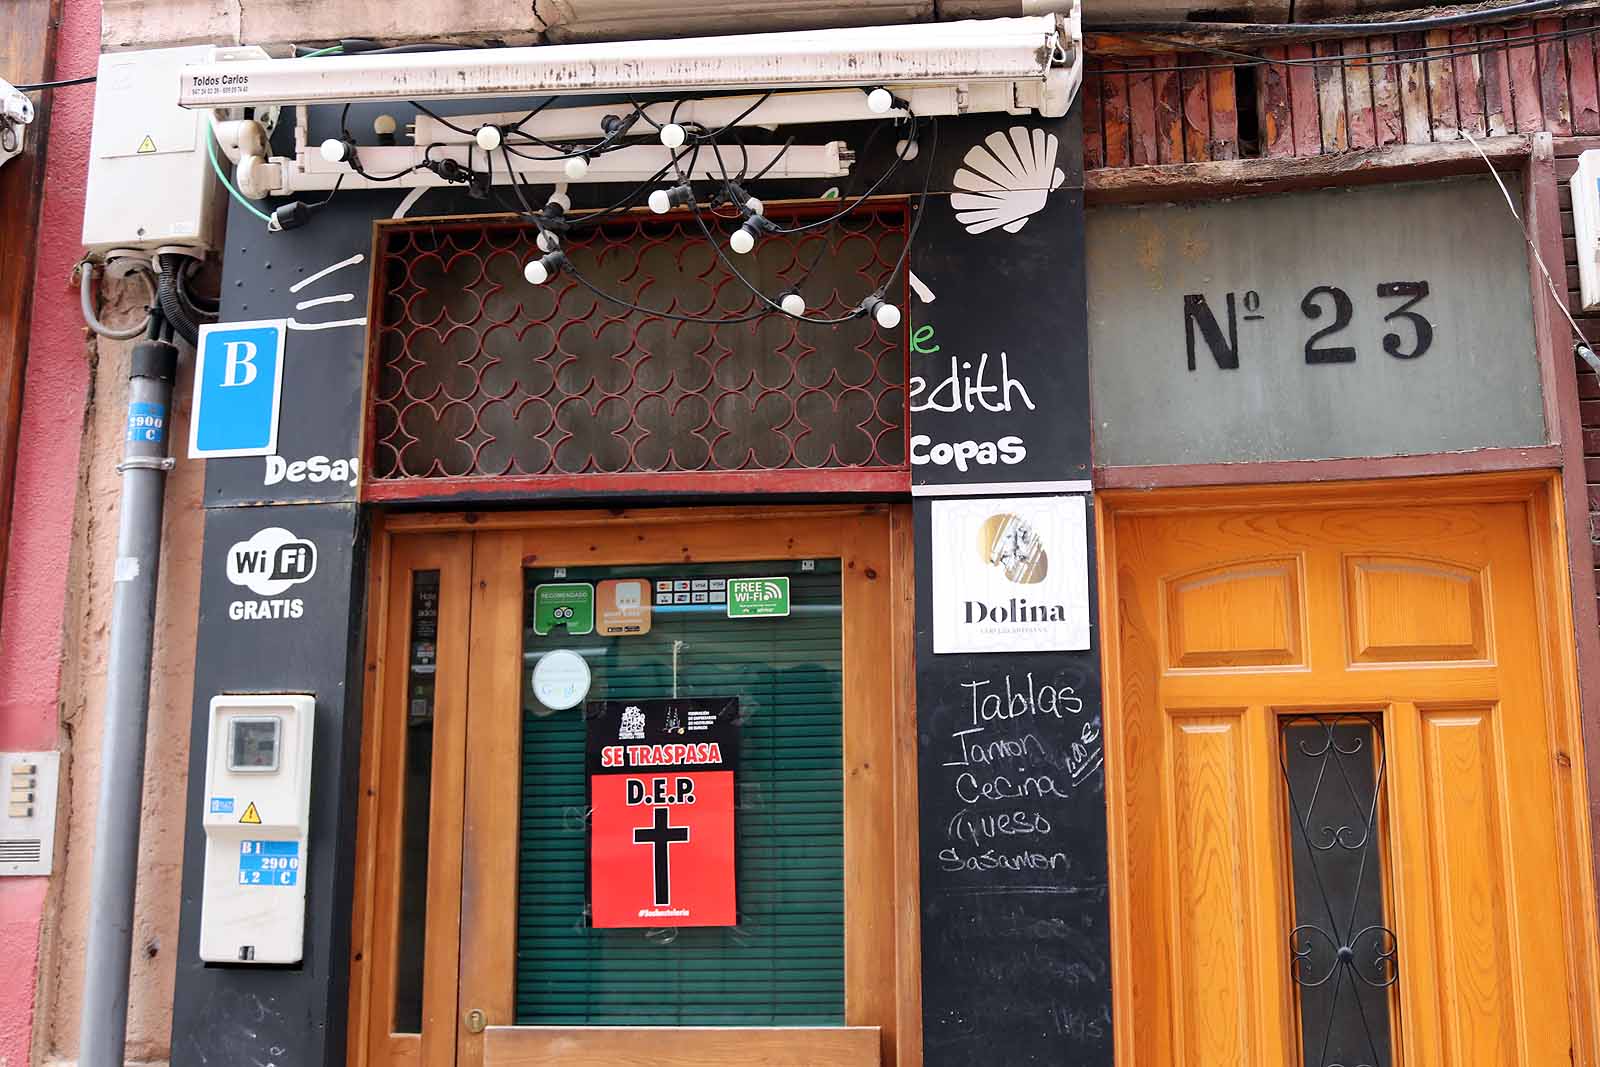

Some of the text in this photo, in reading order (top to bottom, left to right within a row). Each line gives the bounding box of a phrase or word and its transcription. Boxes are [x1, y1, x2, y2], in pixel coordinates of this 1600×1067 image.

[193, 74, 249, 86] Toldos Carlos
[218, 340, 258, 388] B
[145, 429, 156, 441] C
[735, 582, 762, 593] FREE
[736, 591, 763, 602] WI-FI
[228, 598, 304, 621] GRATIS
[963, 598, 1066, 624] Dolina
[960, 672, 1083, 725] Tablas
[601, 743, 723, 768] SE TRASPASA
[626, 777, 696, 806] D.E.P.
[956, 767, 1069, 803] Cecina
[241, 841, 253, 854] B
[261, 857, 298, 869] 2900
[239, 871, 290, 884] L 2 C
